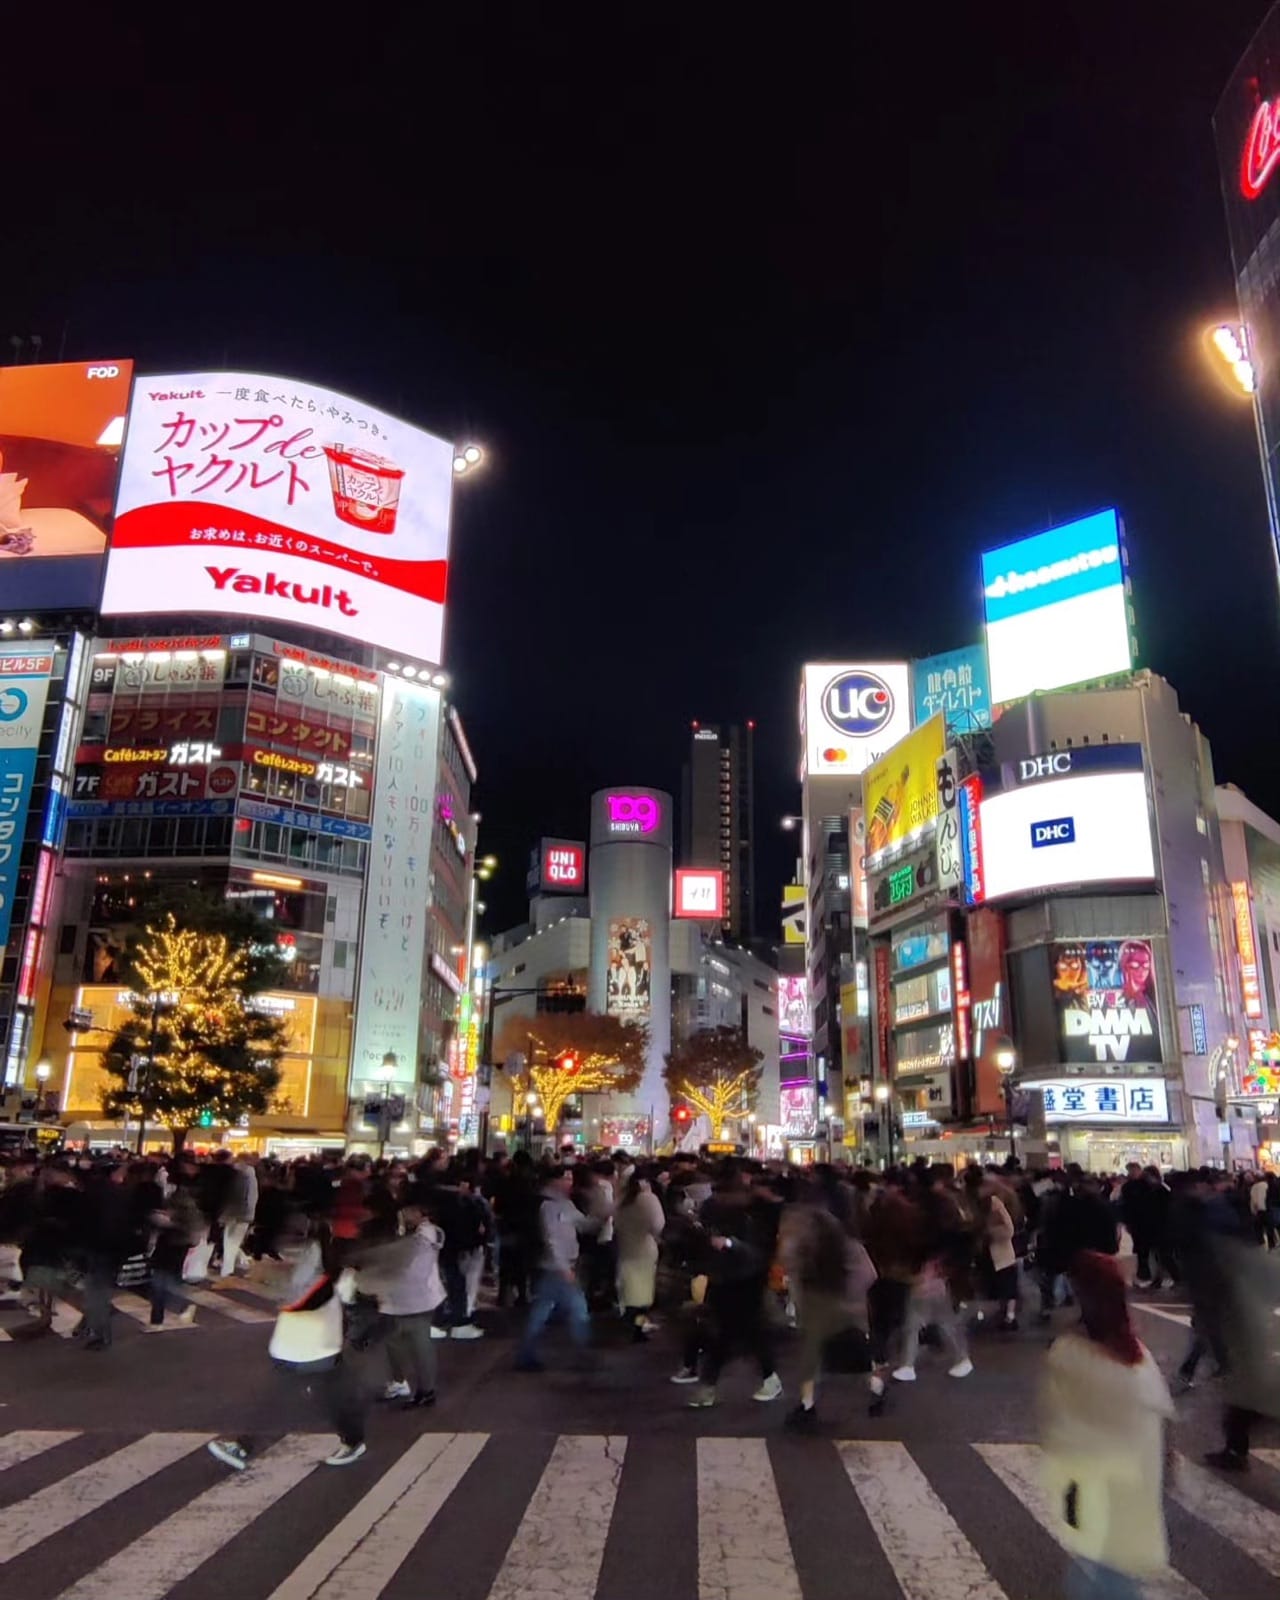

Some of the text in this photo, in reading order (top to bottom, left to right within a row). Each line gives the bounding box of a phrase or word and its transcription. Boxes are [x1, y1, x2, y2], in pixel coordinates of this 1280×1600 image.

[87, 366, 119, 379] FOD
[148, 389, 207, 402] Yakult
[154, 411, 283, 453] カップ
[264, 428, 326, 460] de
[152, 453, 311, 506] ヤクルト
[204, 566, 359, 617] Yakult
[0, 658, 45, 672] ビル5F
[94, 667, 114, 682] 9F
[247, 711, 348, 752] コンタクト
[168, 742, 222, 765] ガスト
[1020, 752, 1071, 780] DHC
[76, 776, 100, 792] 7F
[135, 771, 200, 797] ガスト
[315, 762, 363, 788] ガスト
[608, 796, 659, 832] 109
[610, 822, 640, 832] SHIBUYA
[937, 757, 961, 880] もんじゃ
[1035, 823, 1070, 842] DHC
[549, 851, 575, 864] UNI
[549, 865, 577, 880] QLO
[1064, 1008, 1152, 1036] DMM
[1088, 1035, 1131, 1061] TV
